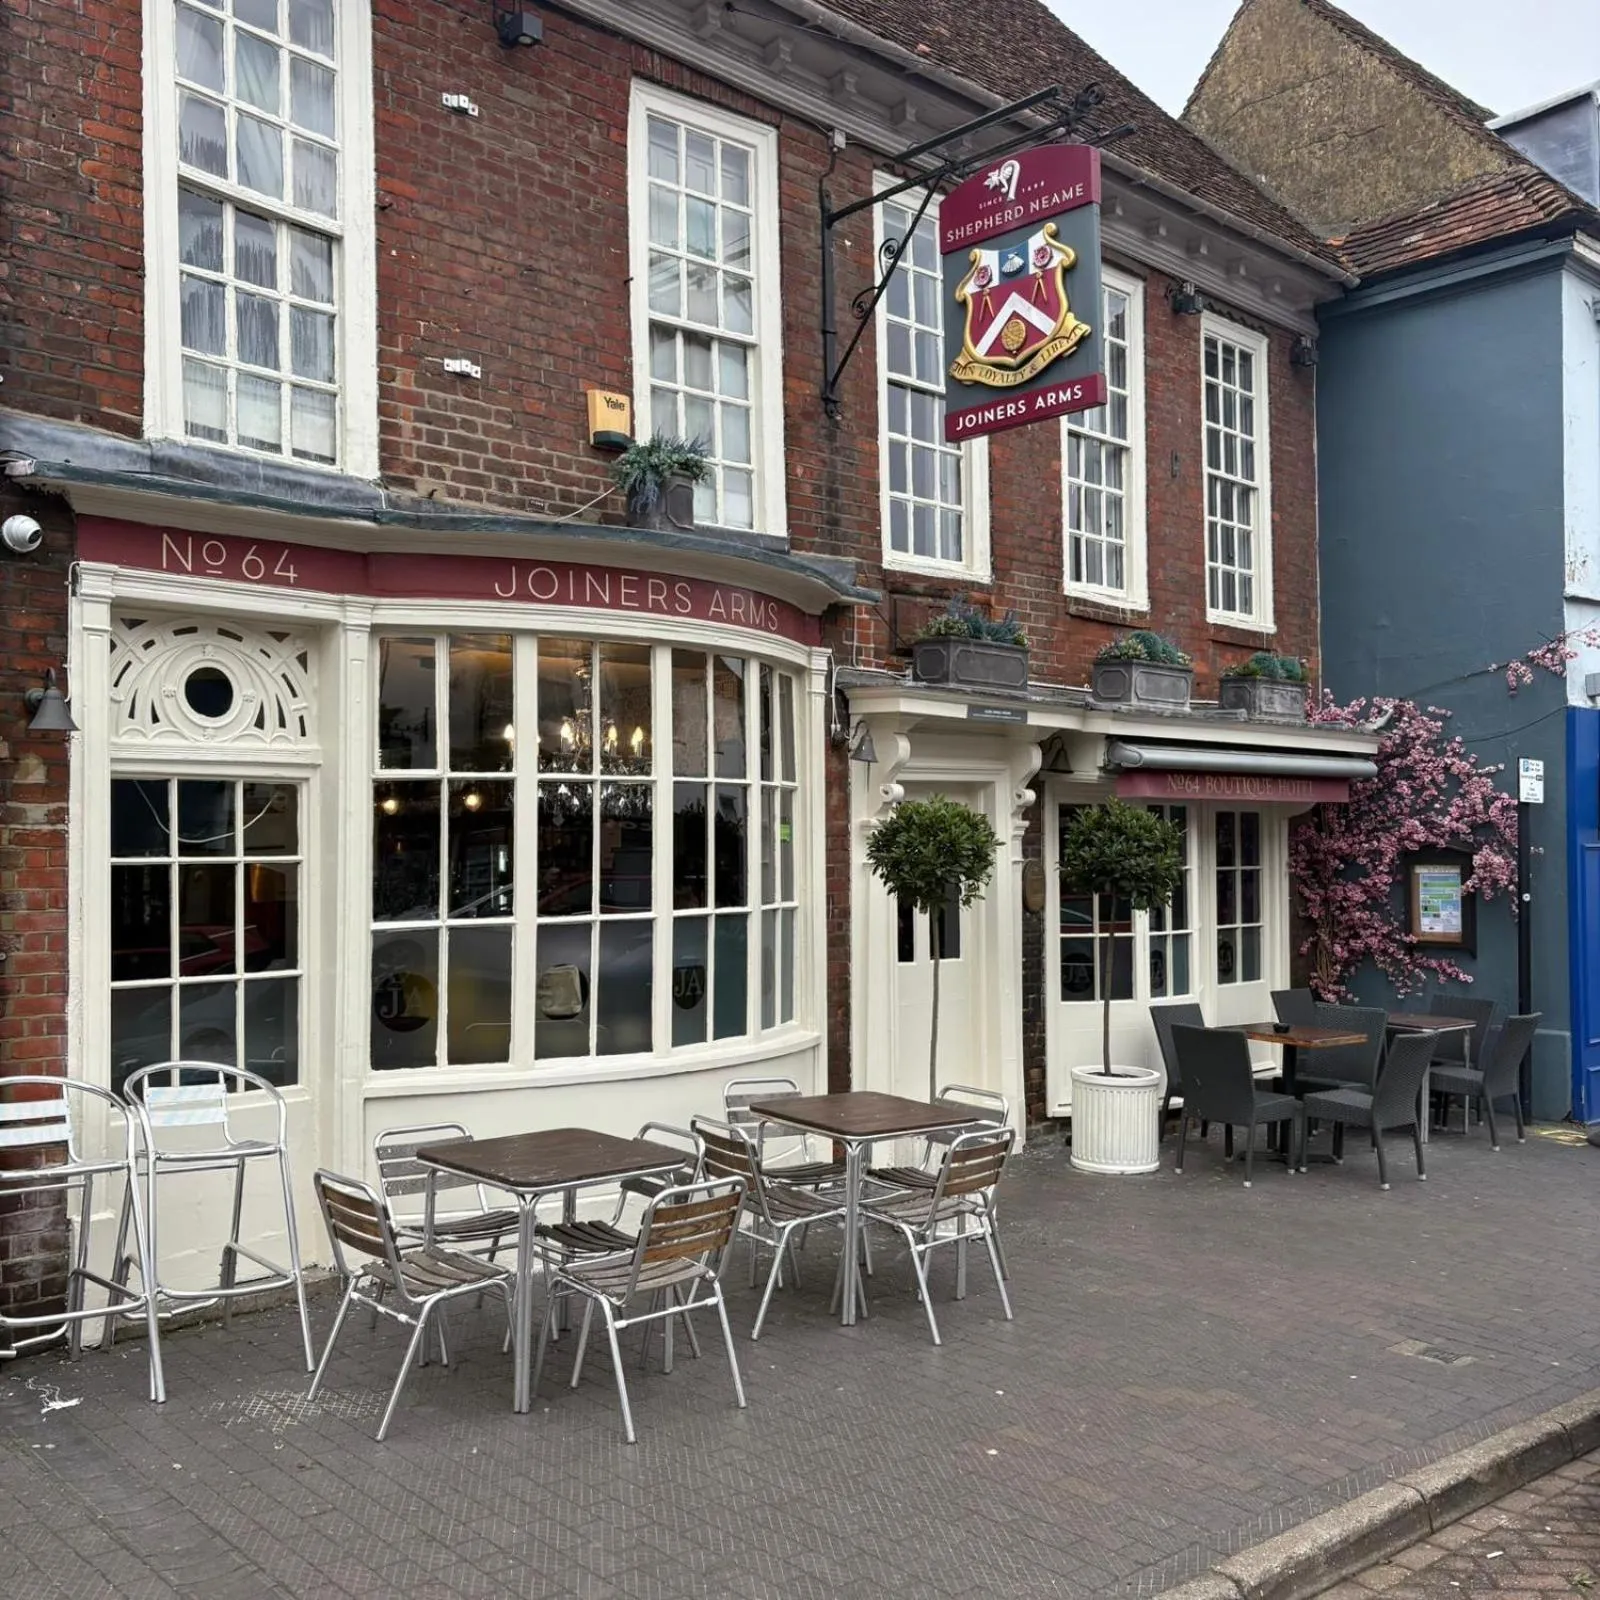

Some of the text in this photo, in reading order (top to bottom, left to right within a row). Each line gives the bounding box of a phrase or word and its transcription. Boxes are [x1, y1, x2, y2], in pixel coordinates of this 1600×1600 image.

[947, 183, 1085, 242] SHEPHERD NEAME
[979, 196, 1003, 210] SINCE
[978, 366, 1026, 384] LOYALTY
[604, 397, 625, 411] Yale
[956, 384, 1083, 431] JOINERS ARMS
[241, 545, 299, 584] 64
[494, 565, 779, 632] JOINERS ARMS
[1205, 776, 1274, 799] BOUTIQUE
[673, 968, 703, 998] JA
